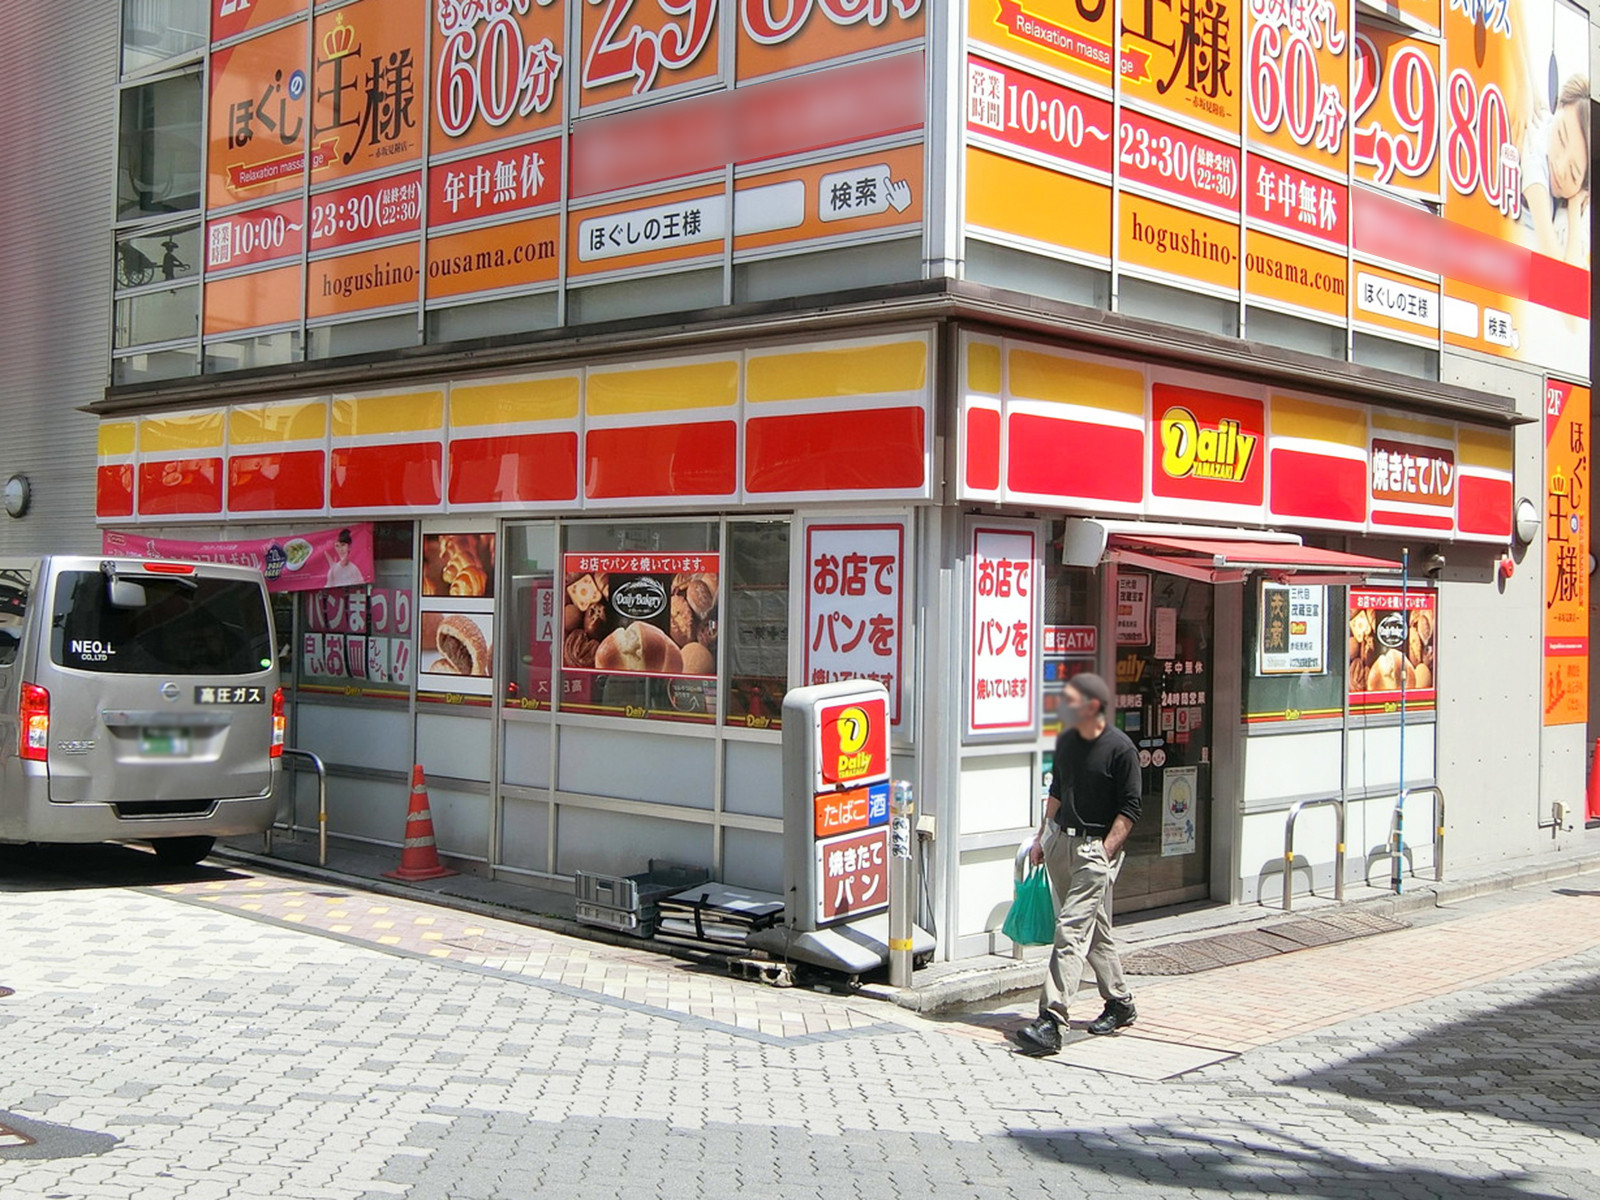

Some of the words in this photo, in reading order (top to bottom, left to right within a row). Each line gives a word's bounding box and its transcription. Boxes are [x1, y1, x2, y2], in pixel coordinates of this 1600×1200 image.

[1015, 14, 1074, 50] Relaxation
[437, 17, 563, 137] 60分
[971, 70, 1000, 99] 営業
[1250, 22, 1346, 153] 60分
[971, 97, 1000, 127] 時間
[239, 164, 280, 184] Relaxation
[443, 152, 545, 214] 年中無休
[830, 177, 877, 212] 検索
[1256, 165, 1337, 232] 年中無休
[589, 209, 701, 251] ほぐしの王様
[322, 239, 555, 297] hogushino-ousama.com
[1132, 212, 1344, 295] hogushino-ousama.com
[1365, 283, 1428, 319] ほぐしの王様
[1547, 388, 1564, 417] 2F
[1160, 406, 1257, 482] Daily
[1372, 447, 1454, 496] 焼きたてパン
[579, 557, 706, 573] お店でパンを焼いています。
[813, 552, 896, 596] お店で
[978, 558, 1029, 598] お店で
[308, 590, 410, 633] パンまつり
[813, 611, 895, 657] パンを
[977, 618, 1028, 657] パンを
[1117, 654, 1146, 682] aily
[200, 687, 261, 703] 高圧ガス
[976, 678, 1027, 700] 焼いています
[824, 799, 866, 828] たばこ
[869, 793, 887, 818] 酒
[828, 841, 883, 877] 焼きたて
[834, 873, 880, 908] パン
